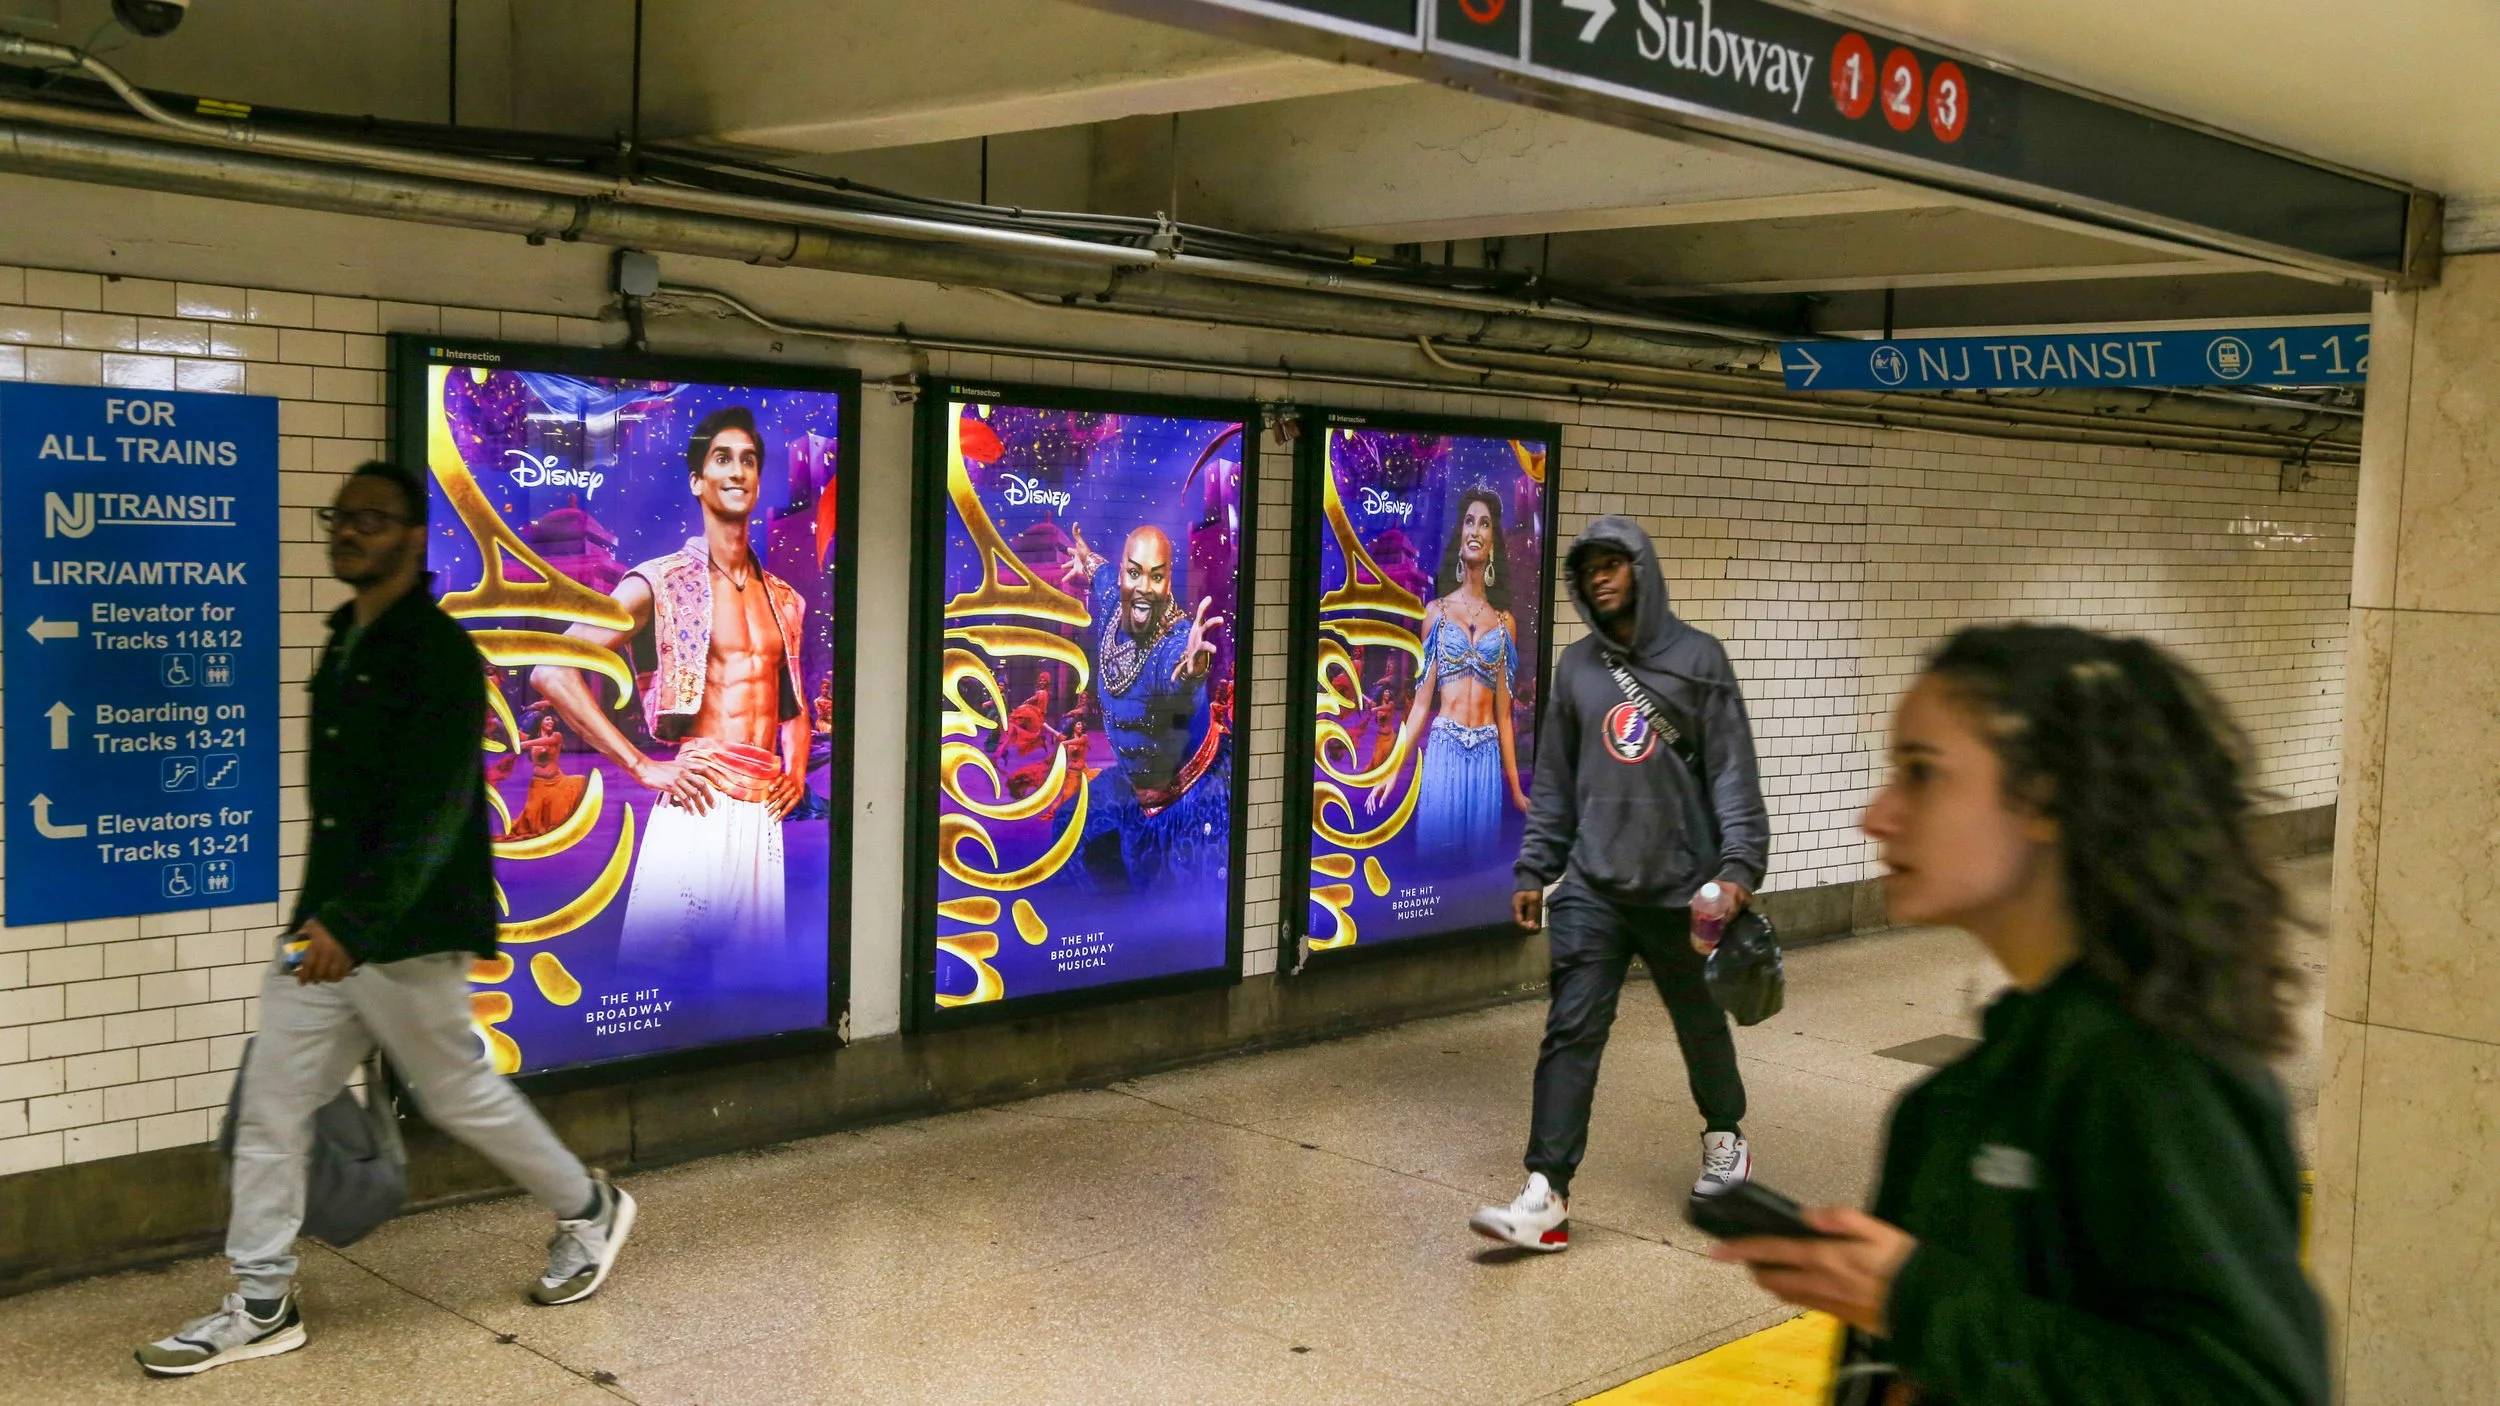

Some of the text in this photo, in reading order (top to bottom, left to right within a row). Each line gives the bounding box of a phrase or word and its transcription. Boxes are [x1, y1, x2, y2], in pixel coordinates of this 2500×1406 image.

[1636, 0, 1958, 130] Subway 1 2 3
[446, 348, 501, 363] Intersection
[1919, 346, 1971, 383] NJ
[1983, 340, 2163, 382] TRANSIT
[961, 386, 1001, 398] Intersection
[105, 398, 177, 428] FOR
[1336, 414, 1367, 424] Intersection
[38, 433, 238, 467] ALL TRAINS
[504, 448, 605, 501] Disney
[1000, 472, 1071, 517] Disney
[1360, 486, 1414, 525] Disney
[44, 491, 237, 539] NJ TRANSIT
[32, 560, 248, 586] LIRR/AMTRAK
[91, 602, 236, 624] Elevator for
[91, 629, 243, 650] Tracks 11&12
[96, 702, 246, 726] Boarding on
[93, 728, 247, 753] Tracks 13-21
[97, 807, 253, 836] Elevators for
[97, 834, 250, 864] Tracks 13-21
[1392, 895, 1441, 910] BROADWAY
[1400, 885, 1434, 898] THE HIT
[1397, 907, 1434, 921] MUSICAL
[1061, 931, 1105, 946] THE HIT
[1050, 942, 1114, 961] BROADWAY
[1058, 956, 1106, 972] MUSICAL
[600, 988, 659, 1006] THE HIT
[586, 1000, 672, 1023] BROADWAY
[596, 1017, 662, 1036] MUSICAL
